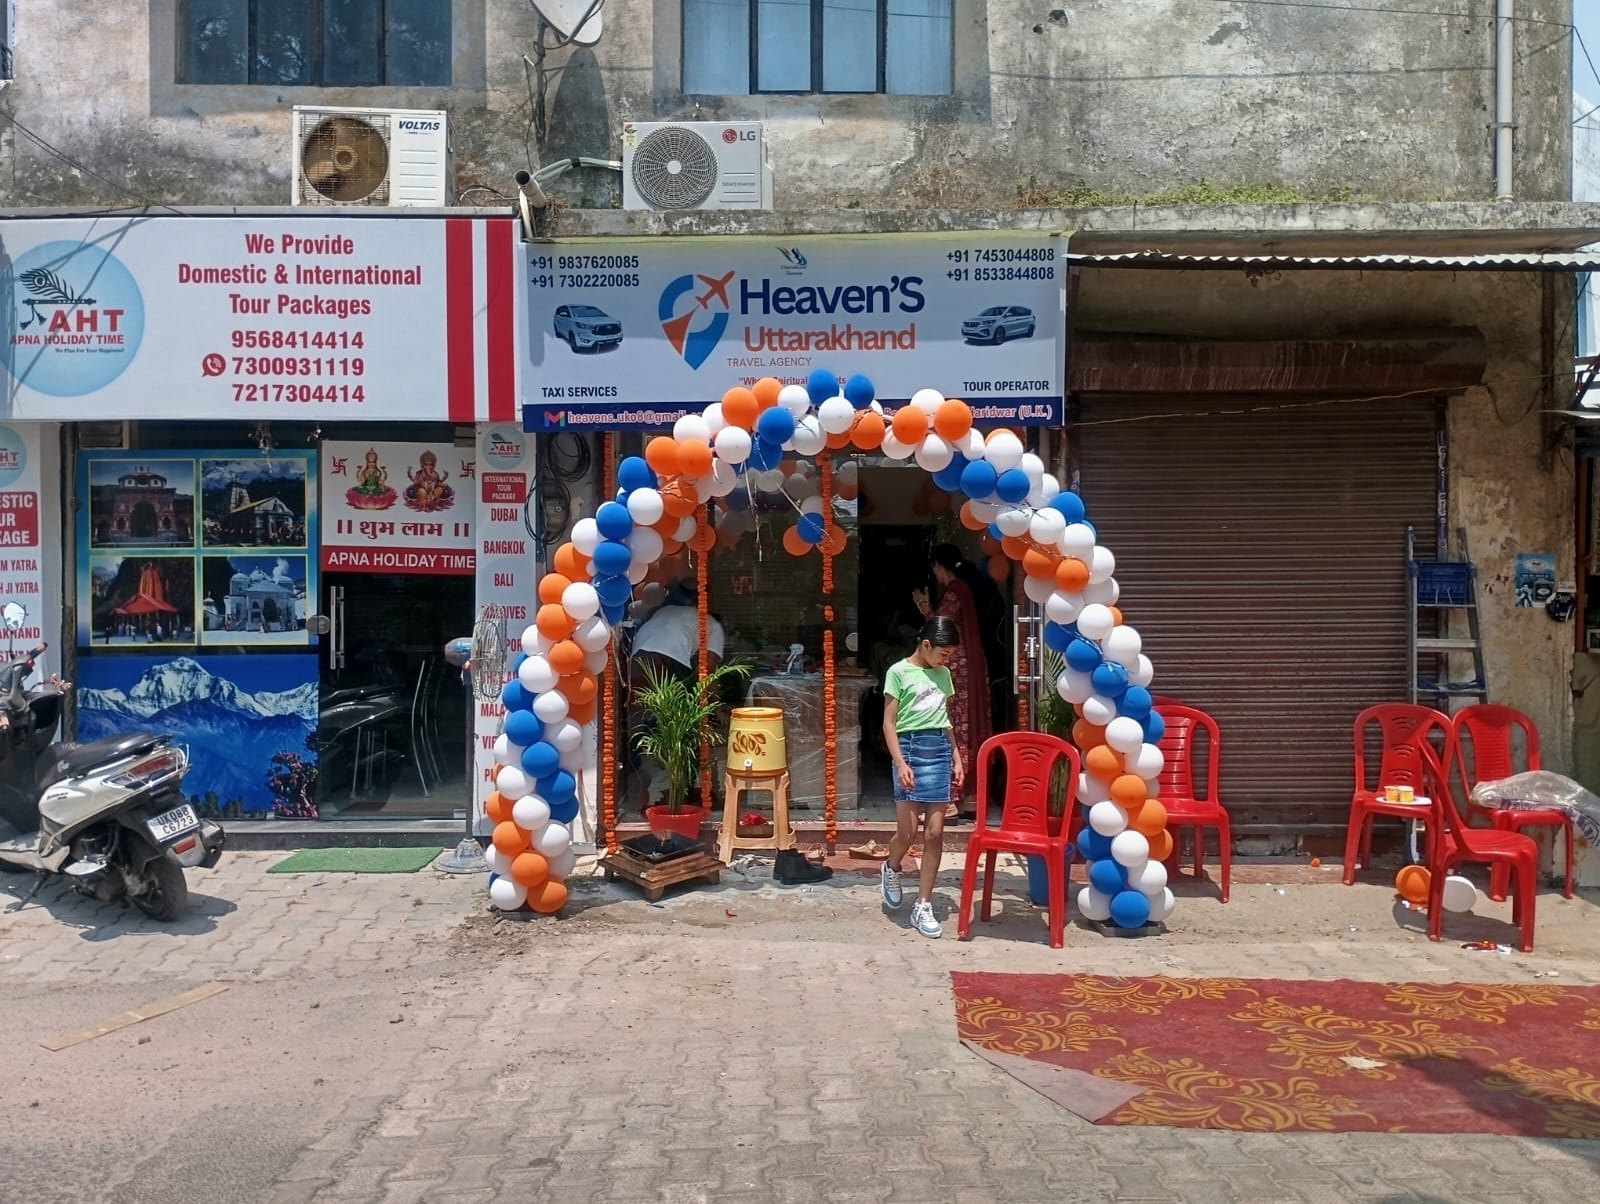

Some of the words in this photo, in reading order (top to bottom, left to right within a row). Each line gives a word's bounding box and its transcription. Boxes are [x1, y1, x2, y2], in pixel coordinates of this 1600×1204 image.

[399, 120, 440, 131] VOLTAS
[740, 131, 756, 141] LG
[245, 234, 275, 254] We
[282, 234, 354, 255] Provide
[947, 250, 969, 262] +91
[974, 248, 1054, 262] 7453044808
[531, 257, 554, 270] +91
[559, 255, 639, 269] 9837620085
[178, 263, 267, 284] Domestic
[274, 264, 288, 285] &
[296, 264, 422, 286] International
[531, 275, 555, 288] +91
[560, 274, 640, 288] 7302220085
[947, 268, 969, 281] +91
[974, 267, 1054, 281] 8533844808
[229, 294, 270, 314] Tour
[277, 294, 371, 319] Packages
[48, 309, 125, 332] AHT
[9, 334, 41, 345] APNA
[44, 334, 93, 345] HOLIDAY
[97, 334, 125, 345] TIME
[231, 330, 365, 349] 9568414414
[744, 323, 916, 352] Uttarakhand
[231, 357, 365, 376] 7300931119
[727, 358, 766, 367] TRAVEL
[769, 357, 812, 367] AGENCY
[542, 387, 565, 397] TAXI
[568, 386, 617, 397] SERVICES
[963, 381, 992, 391] TOUR
[994, 380, 1049, 391] OPERATOR
[232, 384, 365, 402] 7217304414
[1018, 405, 1053, 420] (U.K.)
[491, 508, 518, 521] DUBAI
[360, 521, 395, 540] शुभ
[401, 523, 443, 537] लाभ
[484, 541, 525, 554] BANGKOK
[11, 560, 37, 571] YATRA
[328, 552, 370, 566] APNA
[373, 553, 438, 568] HOLIDAY
[441, 555, 475, 569] TIME
[494, 573, 514, 586] BALI
[15, 582, 39, 593] YATRA
[157, 807, 189, 825] UK08B
[163, 816, 194, 834] C6723
